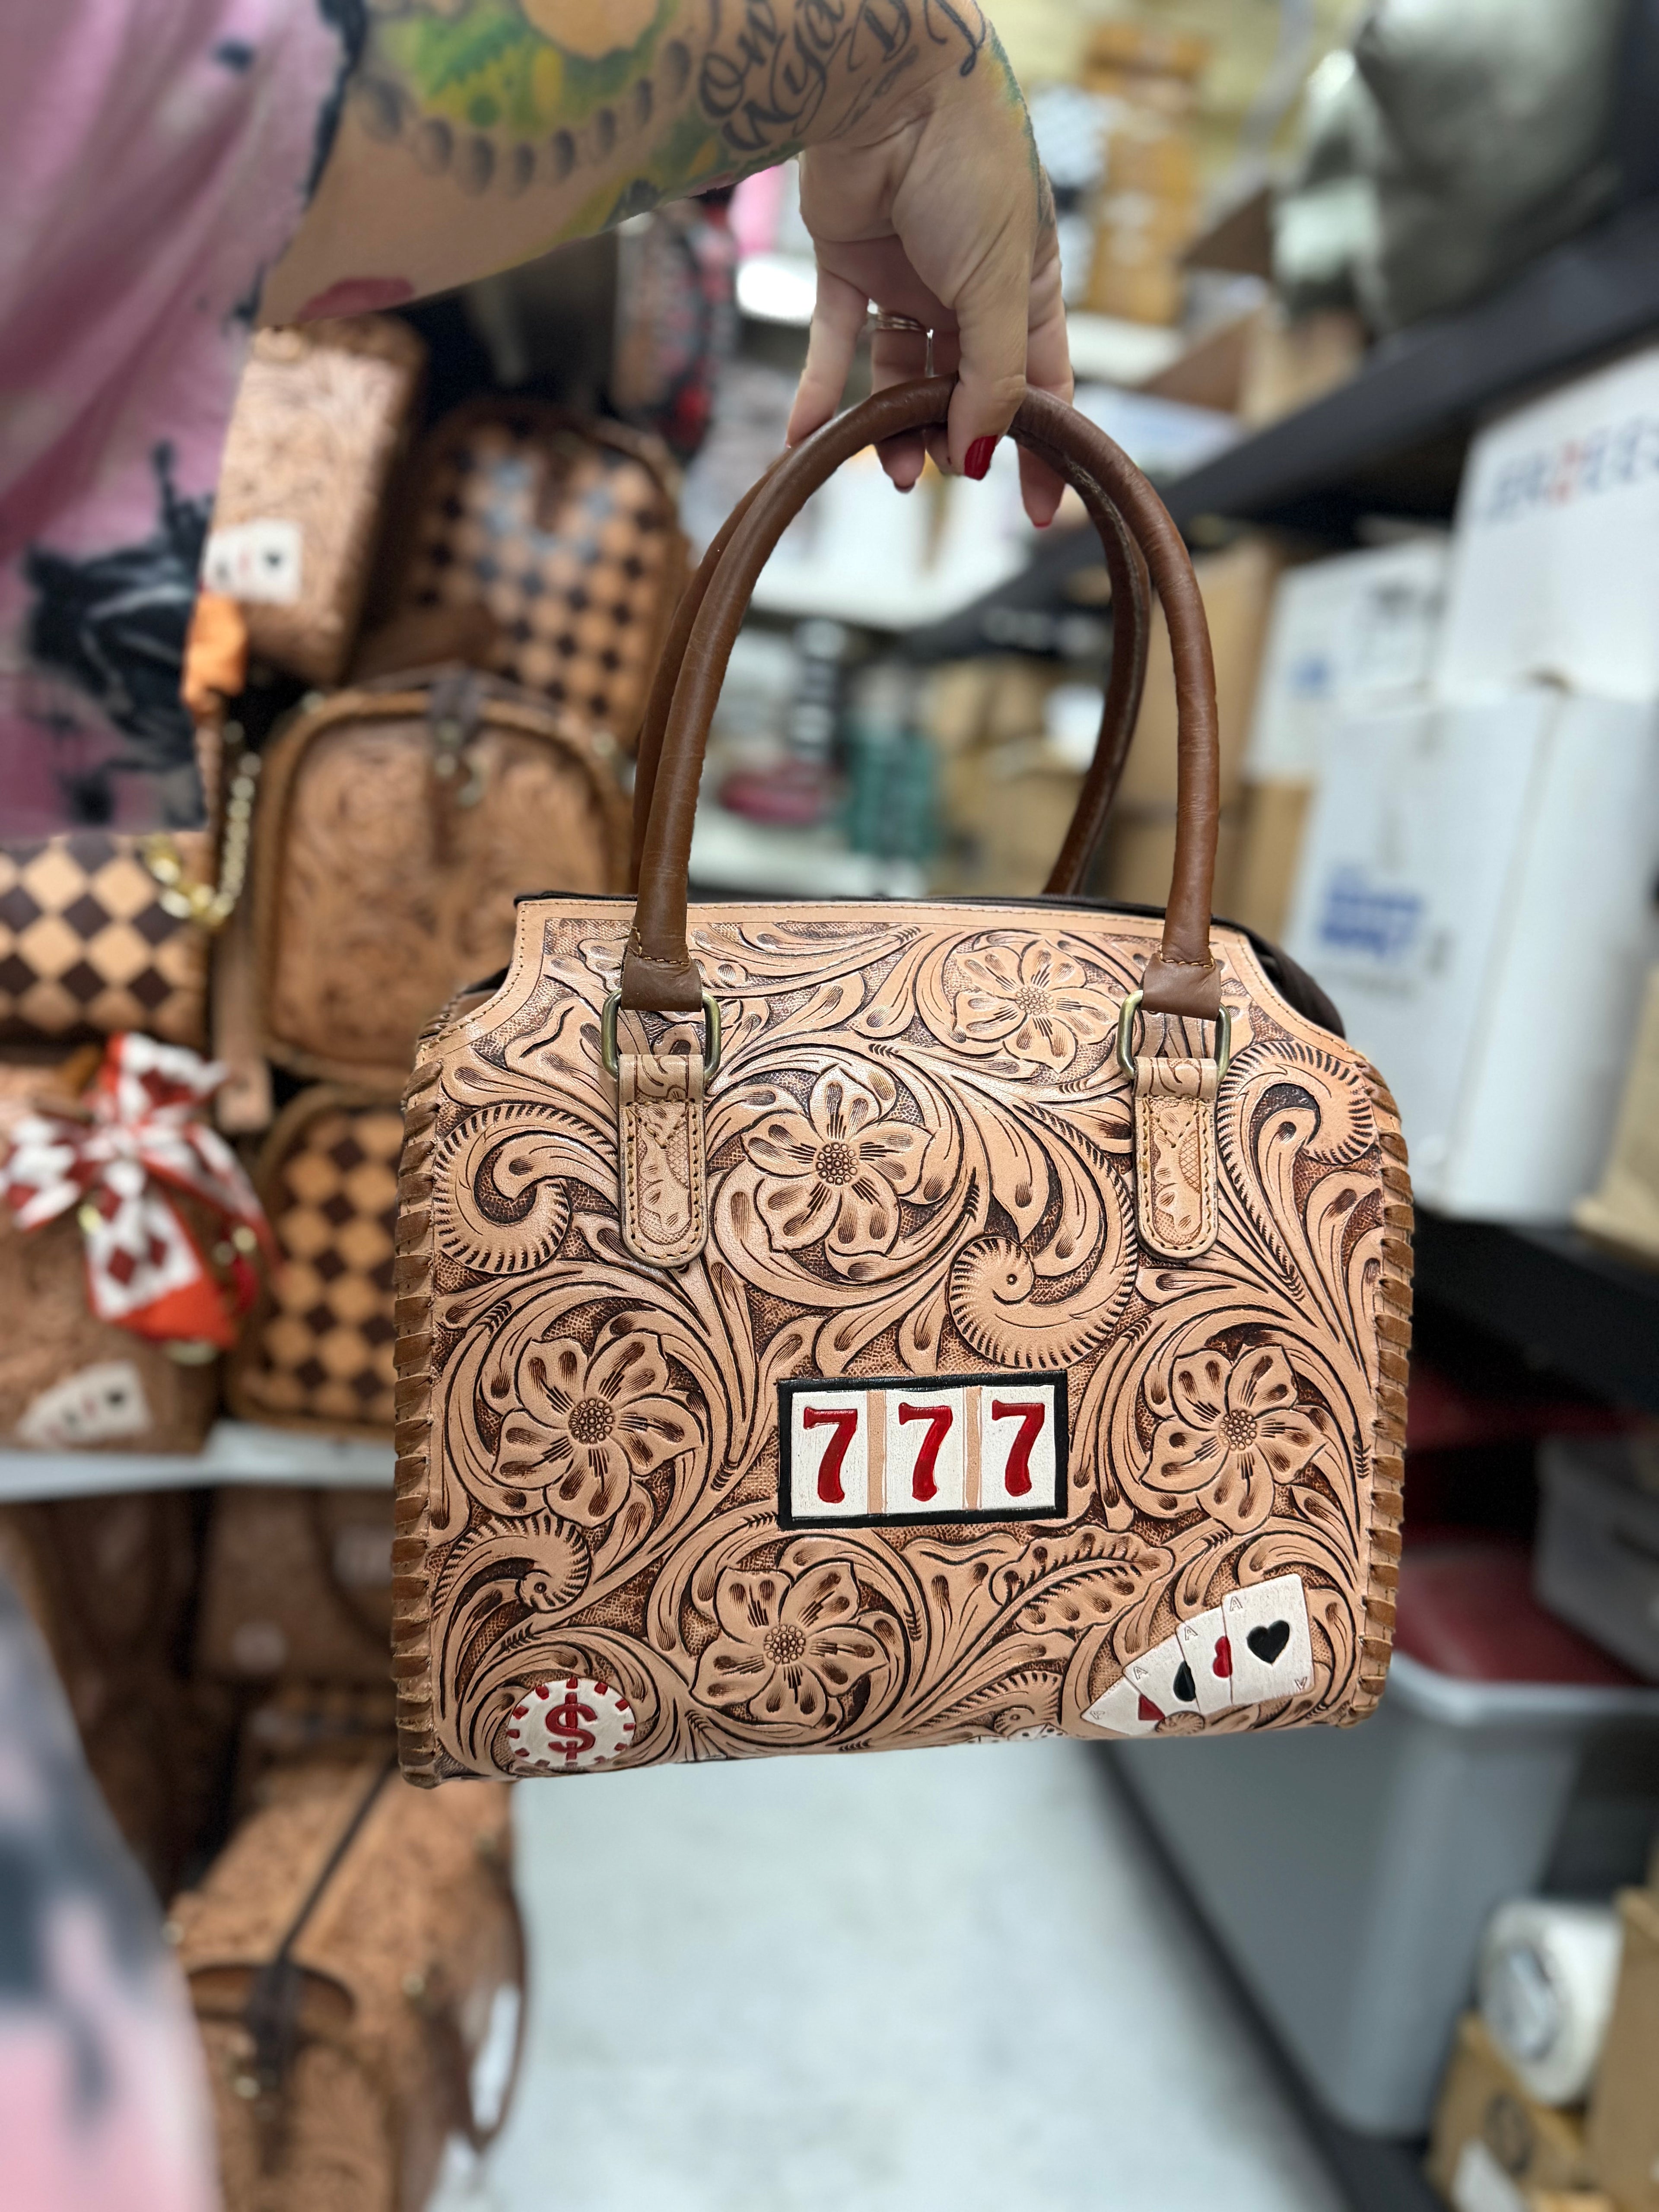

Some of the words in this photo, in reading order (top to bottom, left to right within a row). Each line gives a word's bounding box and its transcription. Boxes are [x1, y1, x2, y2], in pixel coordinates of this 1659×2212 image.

[1230, 1595, 1243, 1611] A
[1184, 1625, 1199, 1641] A
[1133, 1666, 1149, 1681] A
[545, 1692, 598, 1761] $
